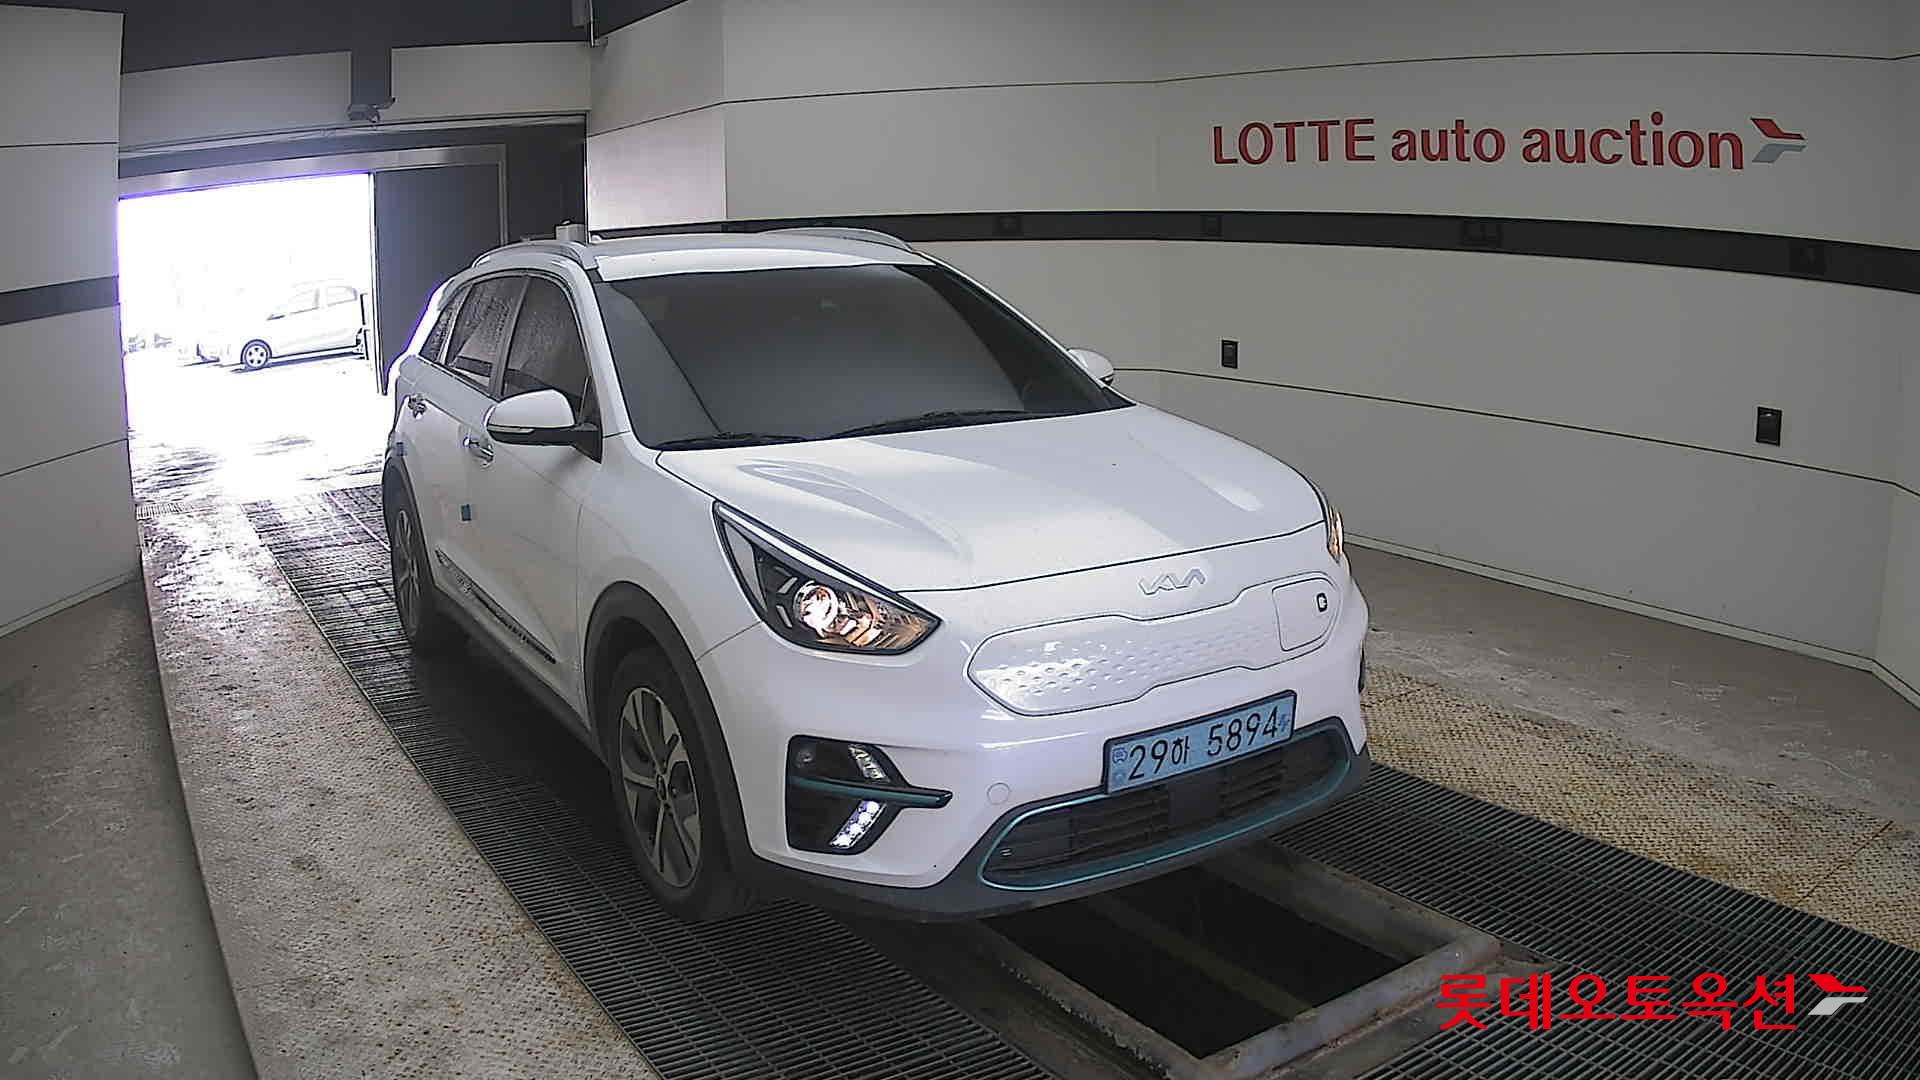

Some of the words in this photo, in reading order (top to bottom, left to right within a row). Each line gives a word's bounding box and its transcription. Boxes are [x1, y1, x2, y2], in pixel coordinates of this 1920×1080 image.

[1213, 118, 1376, 165] LOTTE
[1391, 118, 1505, 163] auto
[1521, 111, 1744, 170] auction
[1128, 735, 1190, 781] 29하
[1207, 706, 1279, 756] 5894
